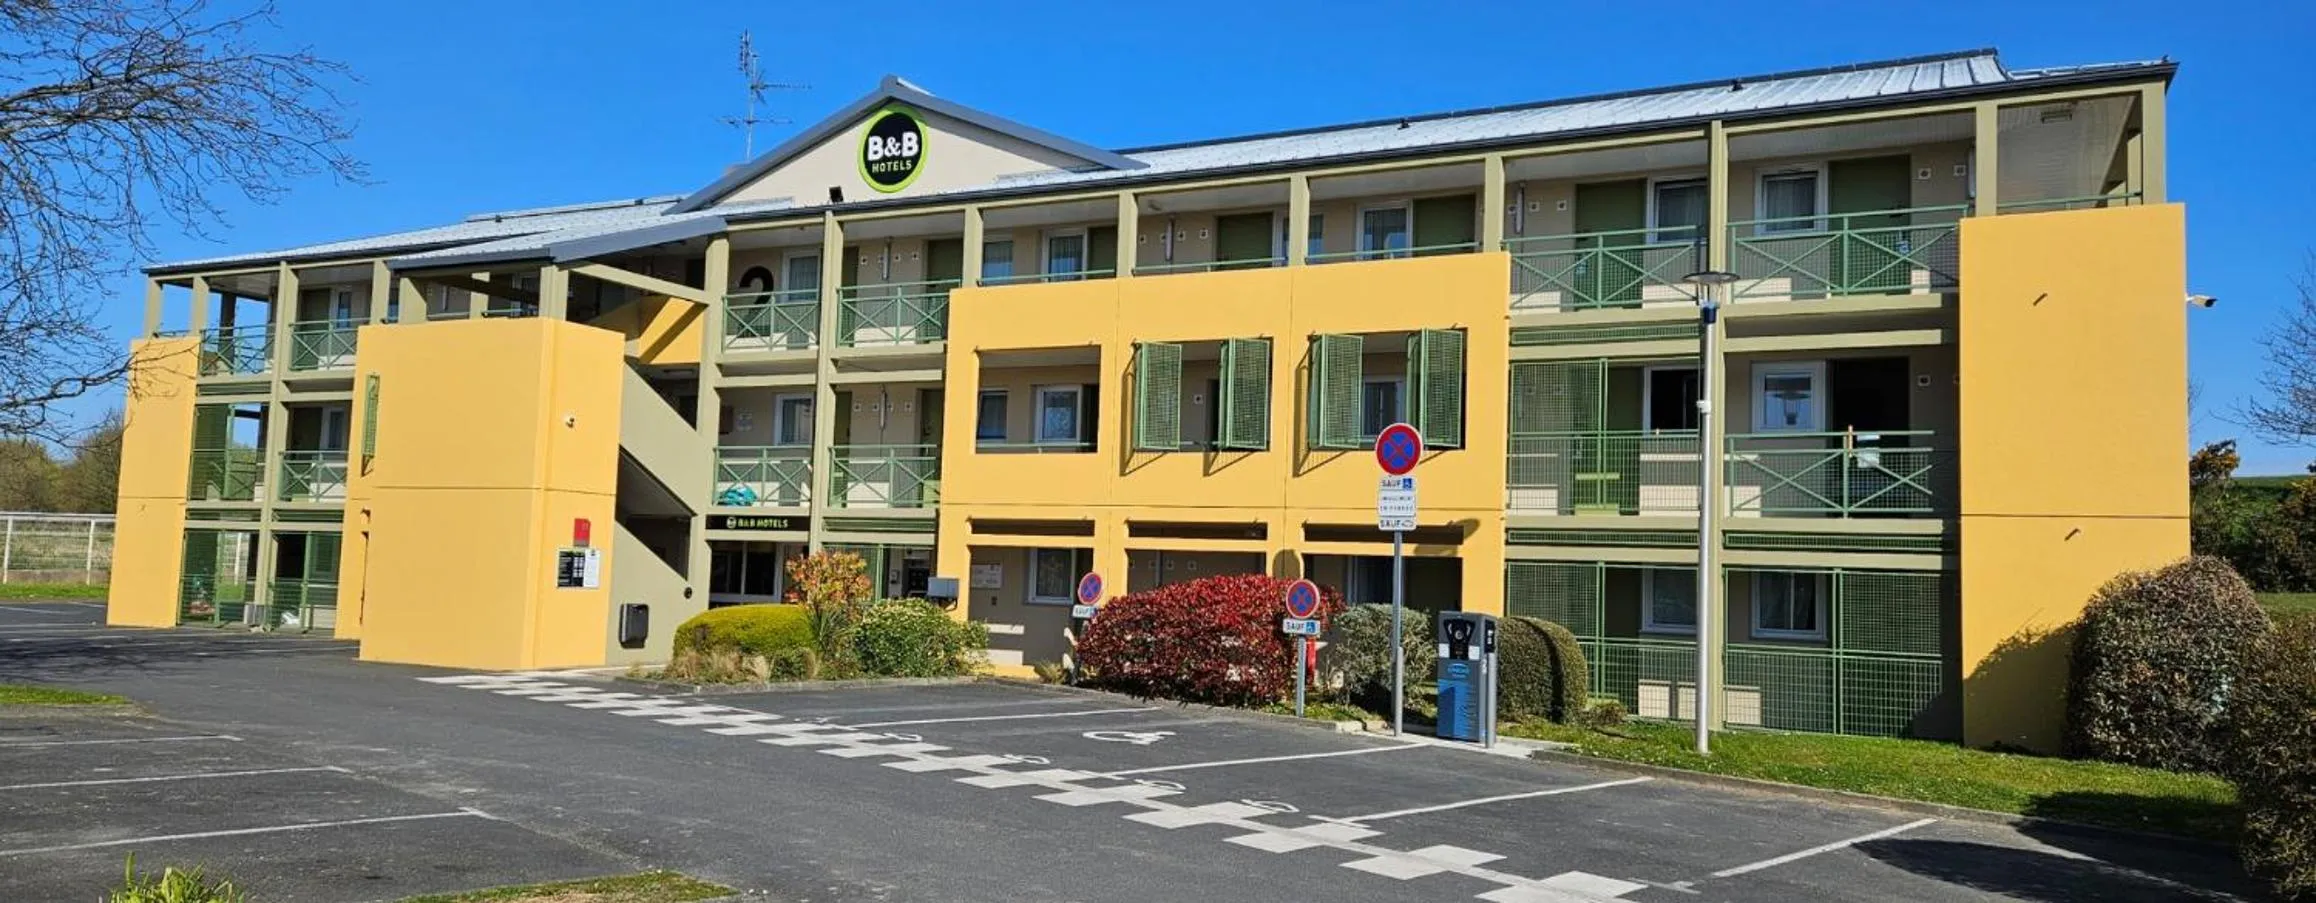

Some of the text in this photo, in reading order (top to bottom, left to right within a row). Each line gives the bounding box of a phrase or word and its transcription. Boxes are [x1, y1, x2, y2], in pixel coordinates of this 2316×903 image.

[867, 131, 919, 161] B&B
[872, 160, 912, 173] HOTELS
[757, 518, 788, 529] HOTELS
[1380, 519, 1401, 528] SAUF
[1286, 621, 1304, 630] SAUF
